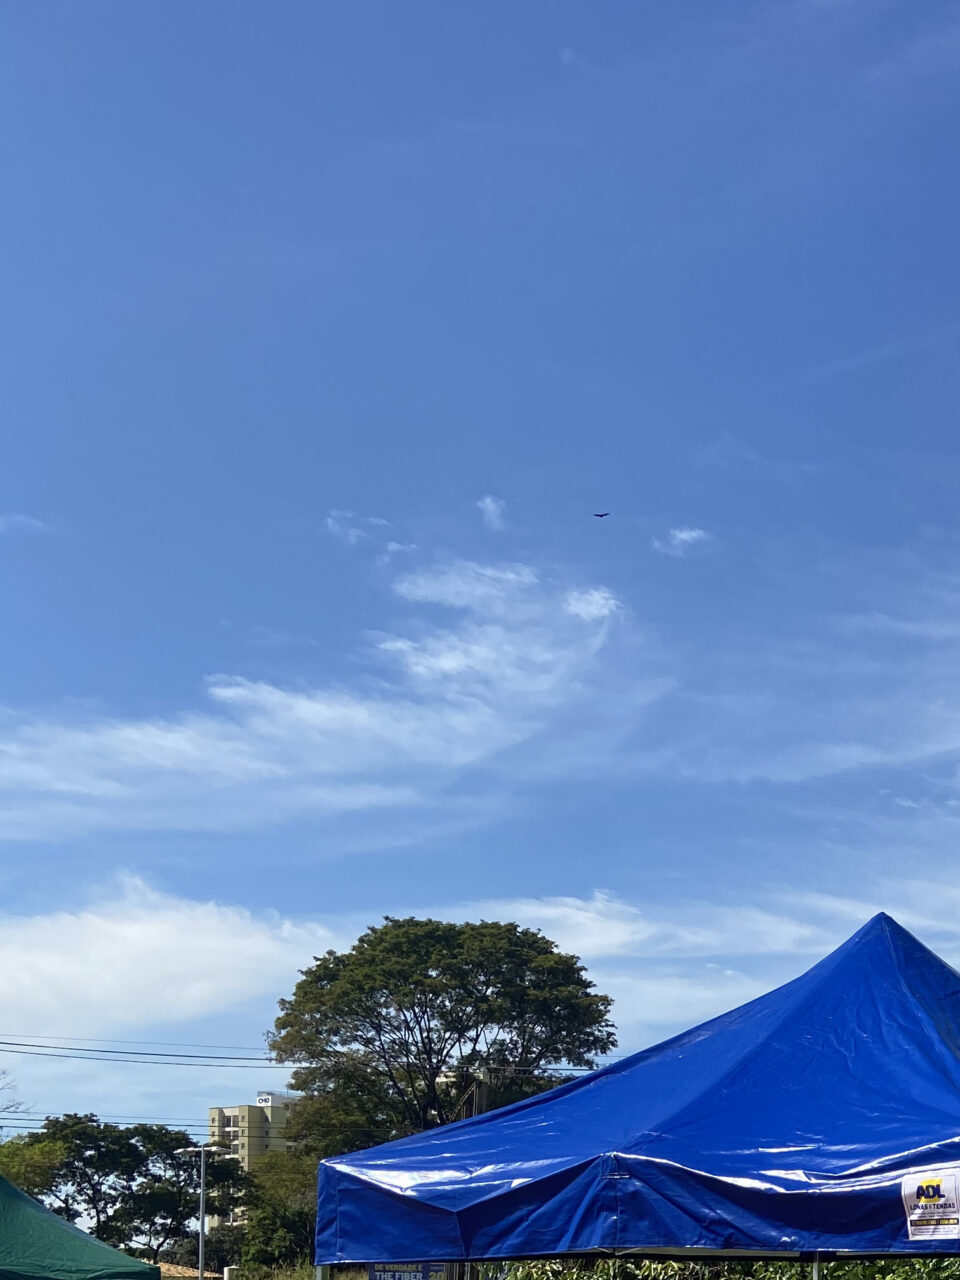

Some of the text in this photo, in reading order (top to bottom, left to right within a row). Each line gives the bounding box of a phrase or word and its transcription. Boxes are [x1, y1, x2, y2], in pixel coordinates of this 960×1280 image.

[916, 1184, 945, 1199] ADL
[375, 1271, 423, 1280] THE FIBER
